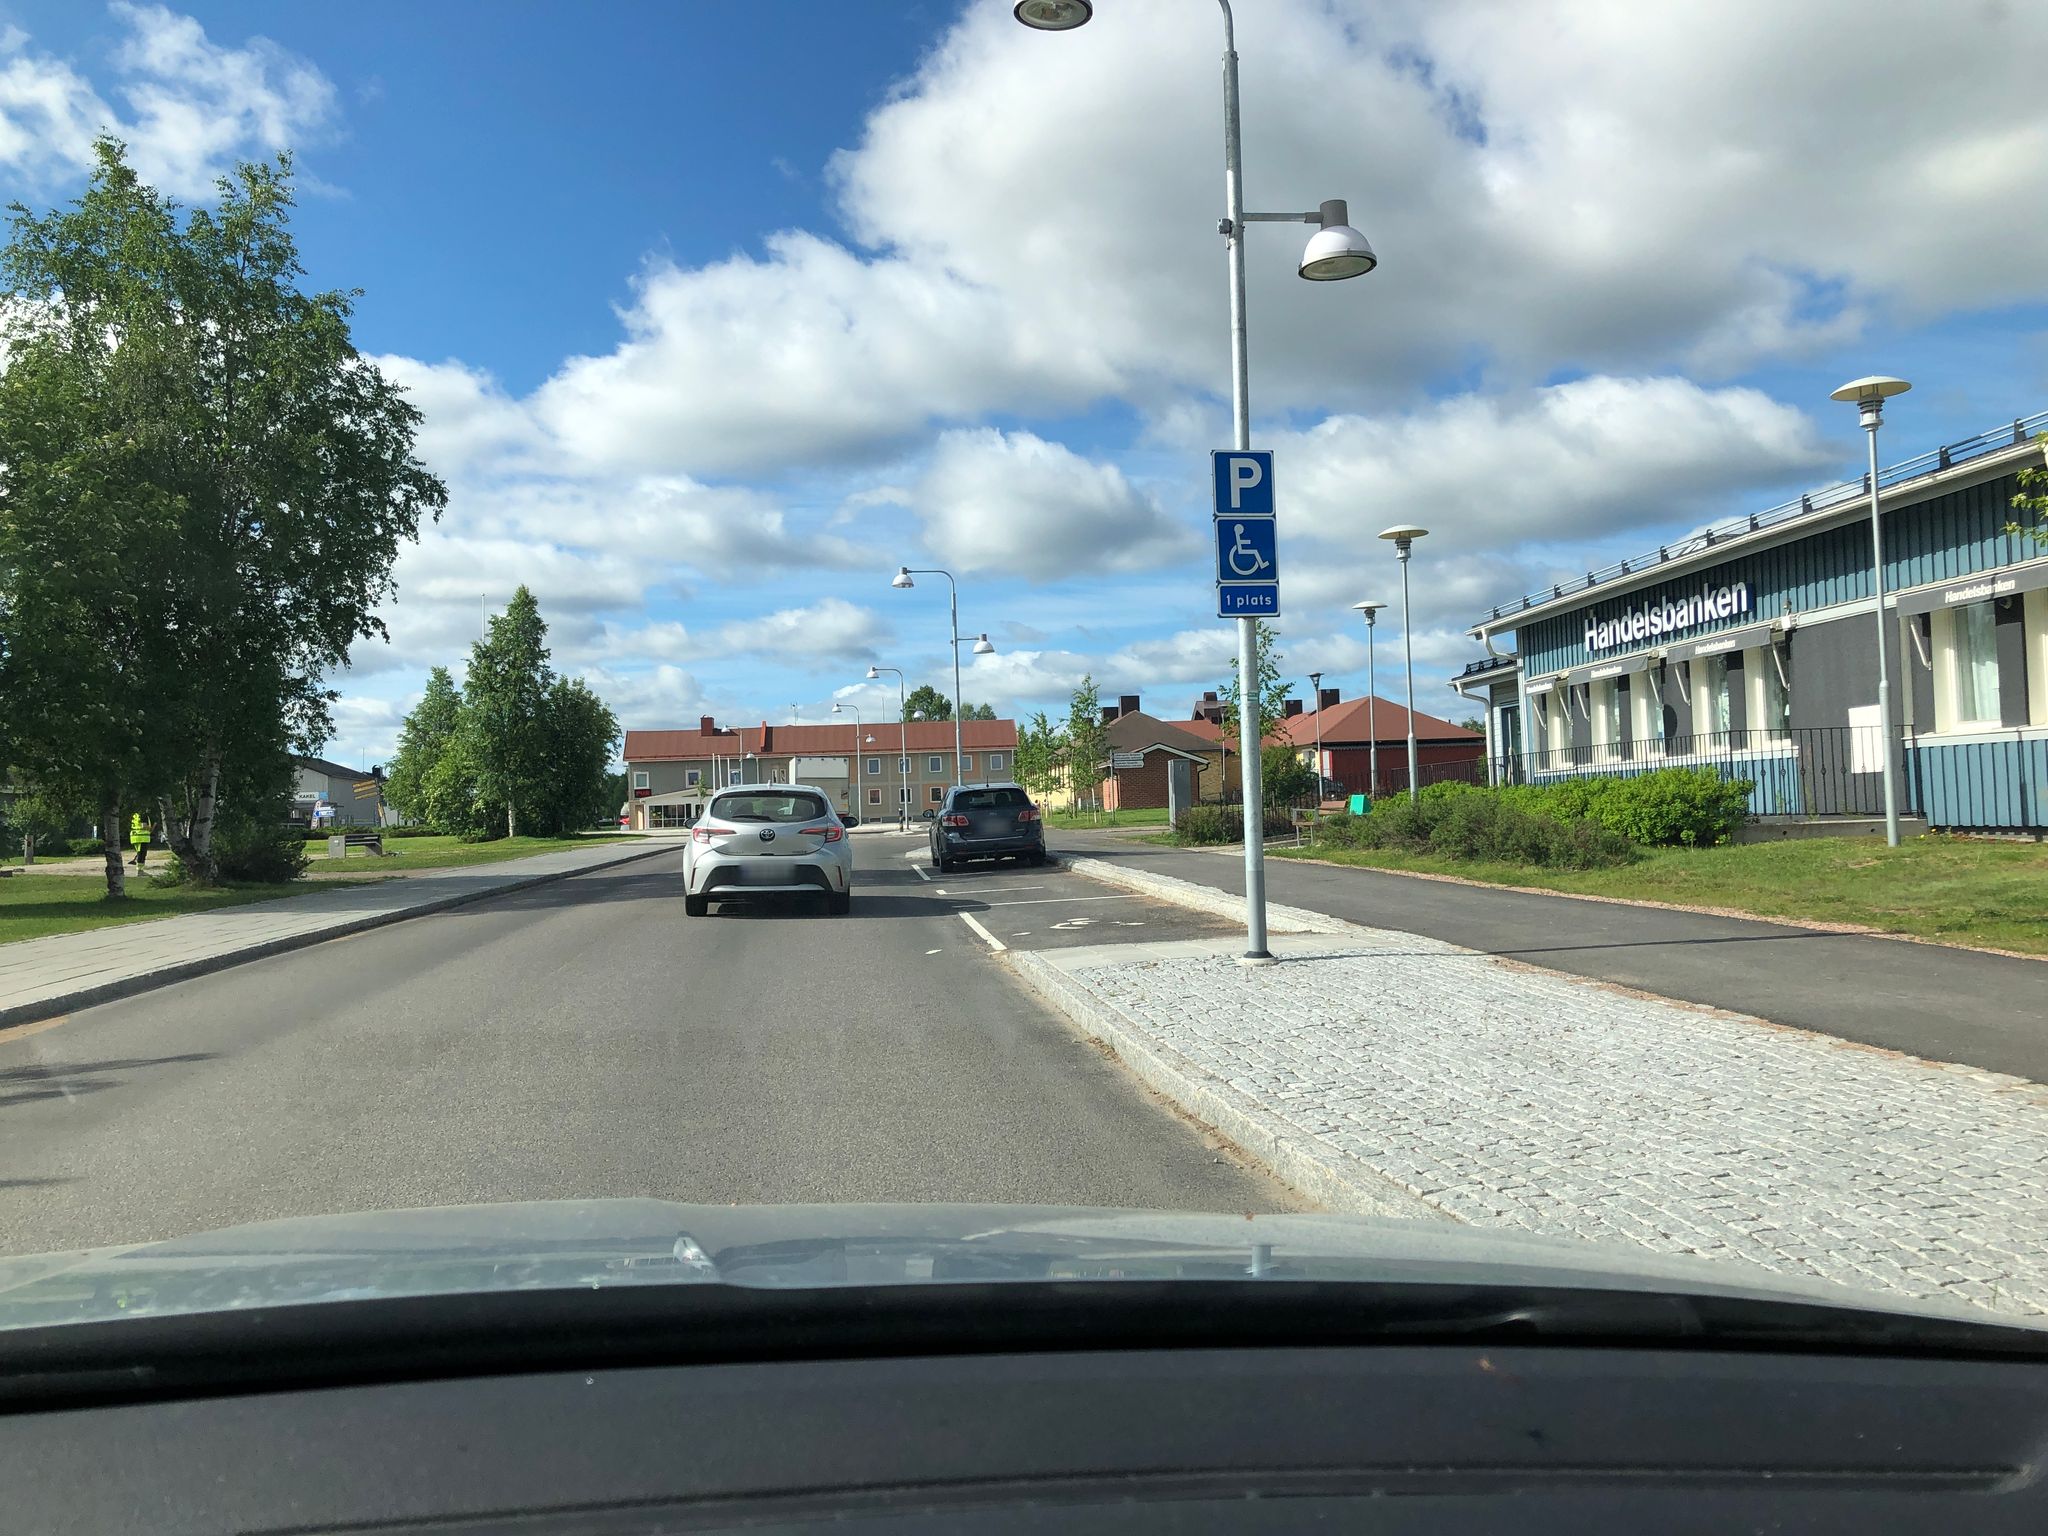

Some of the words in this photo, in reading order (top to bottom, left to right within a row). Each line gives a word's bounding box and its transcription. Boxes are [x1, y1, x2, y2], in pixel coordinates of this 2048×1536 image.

[1229, 457, 1263, 509] P
[1226, 594, 1231, 606] 1
[1236, 594, 1272, 608] plats
[1945, 580, 2015, 603] Handelsbanken
[1584, 581, 1748, 653] Handelsbanken
